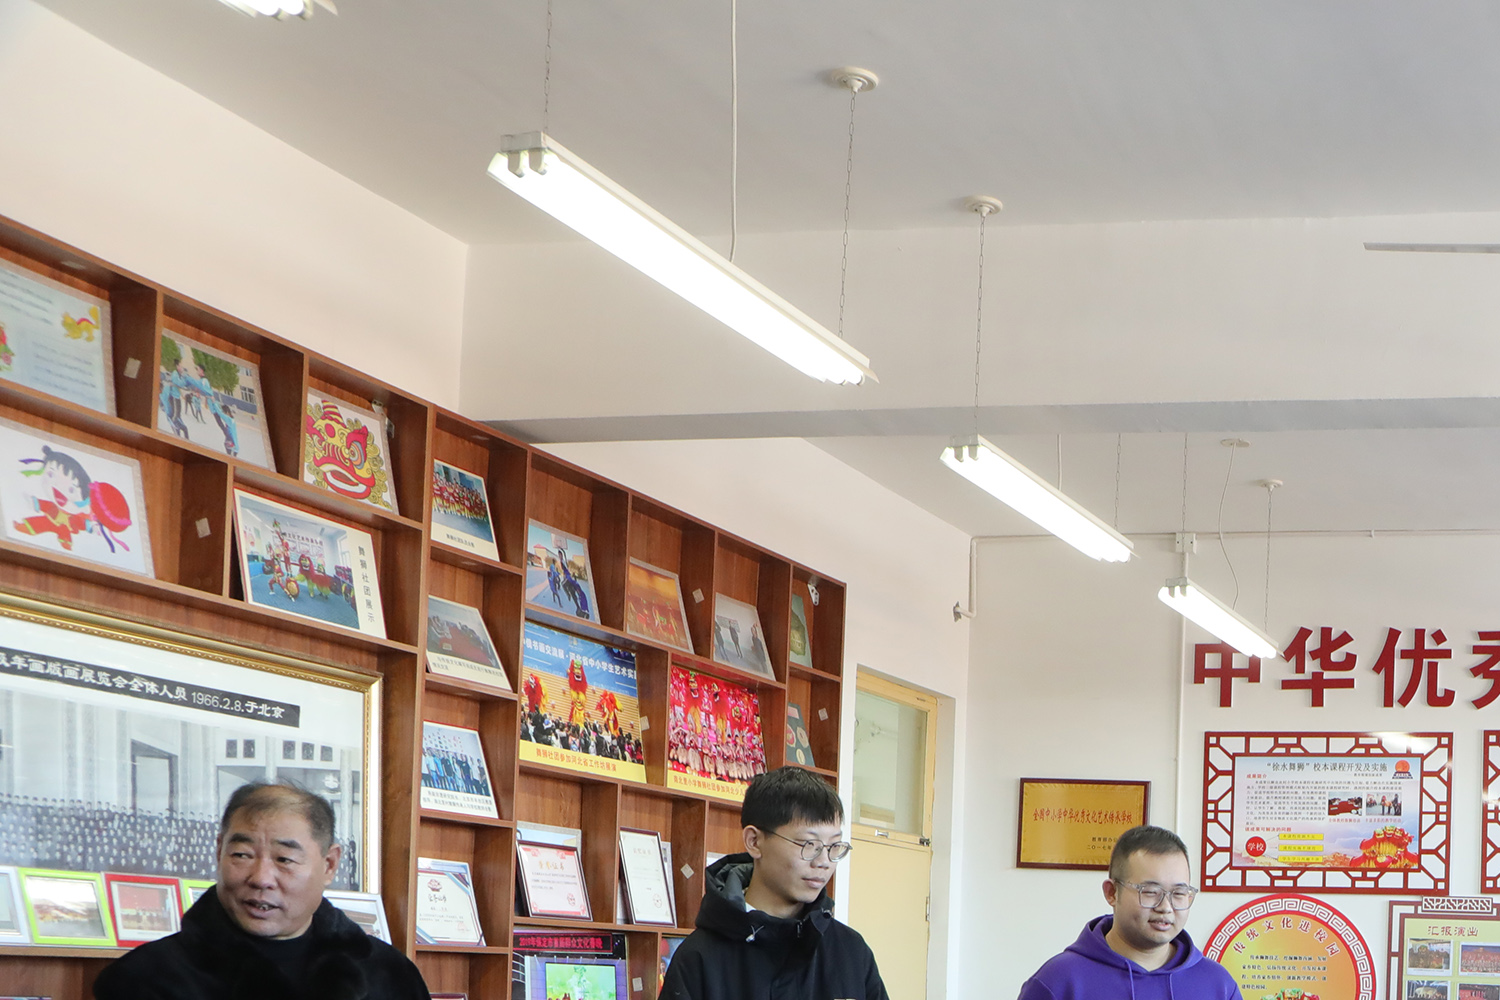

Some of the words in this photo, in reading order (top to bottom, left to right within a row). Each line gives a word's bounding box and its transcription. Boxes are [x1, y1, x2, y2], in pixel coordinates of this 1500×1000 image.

[358, 546, 374, 622] 舞狮社团展示
[1247, 841, 1264, 852] 学校
[1232, 917, 1340, 956] 传统文化进校园
[1427, 925, 1479, 937] 汇报演出
